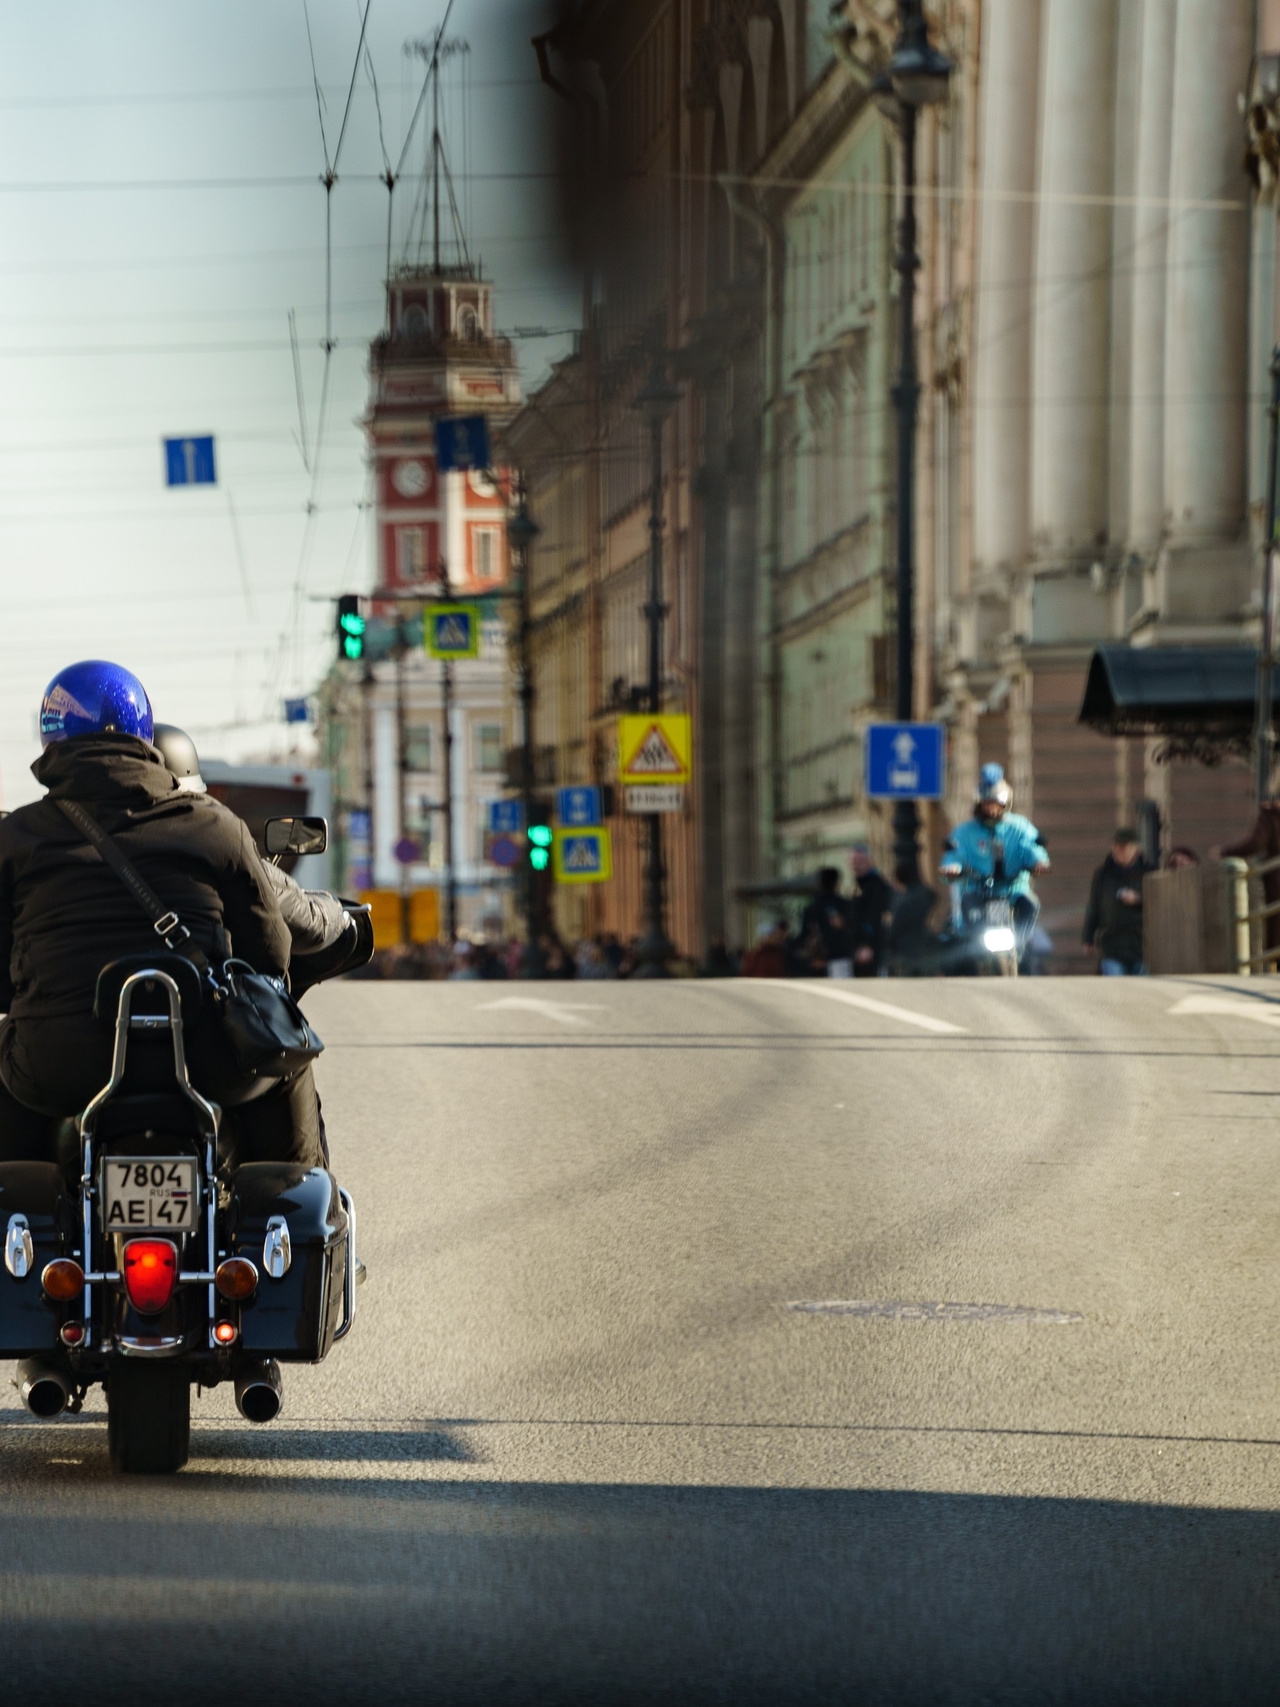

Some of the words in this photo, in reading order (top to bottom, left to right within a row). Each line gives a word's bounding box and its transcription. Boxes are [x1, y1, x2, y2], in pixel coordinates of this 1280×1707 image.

[118, 1164, 182, 1188] 7804
[149, 1188, 172, 1198] RUS
[108, 1200, 146, 1224] AE
[157, 1200, 189, 1224] 47
